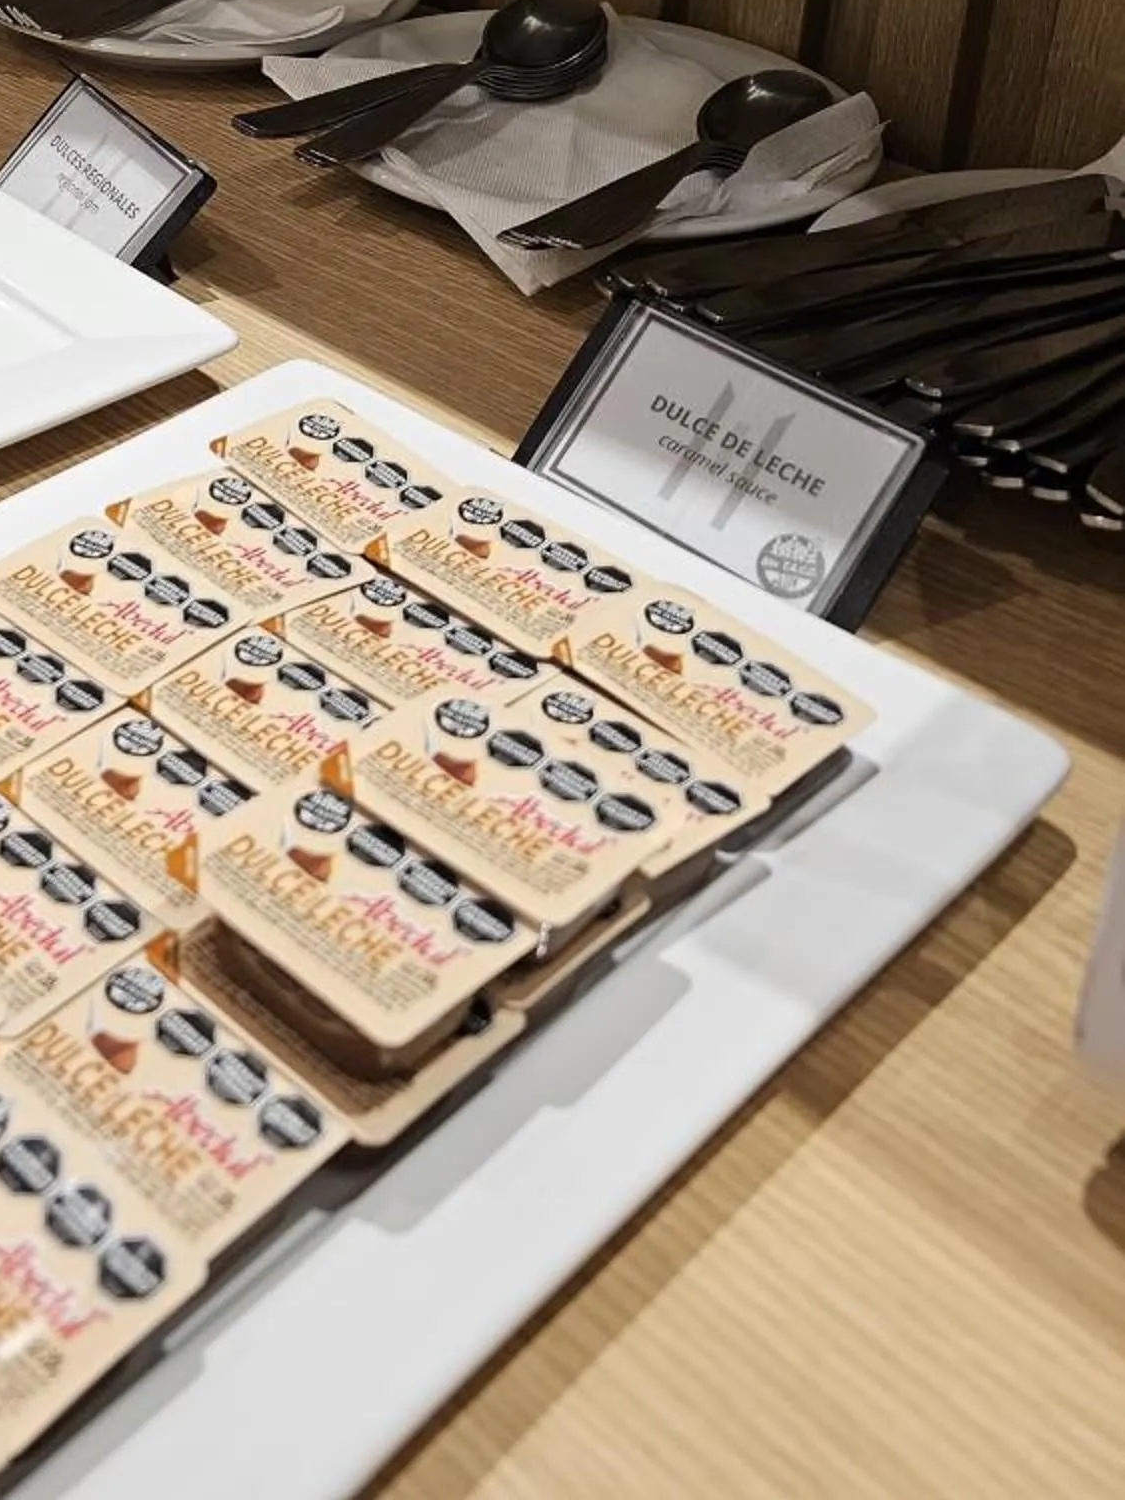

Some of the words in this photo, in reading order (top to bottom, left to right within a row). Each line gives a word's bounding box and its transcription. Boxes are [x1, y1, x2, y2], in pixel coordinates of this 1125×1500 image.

[81, 164, 141, 220] REGIONALES
[650, 394, 719, 442] DULCE
[720, 430, 753, 460] DE
[753, 447, 827, 498] LECHE
[658, 432, 725, 478] caramel
[724, 470, 780, 507] sauce
